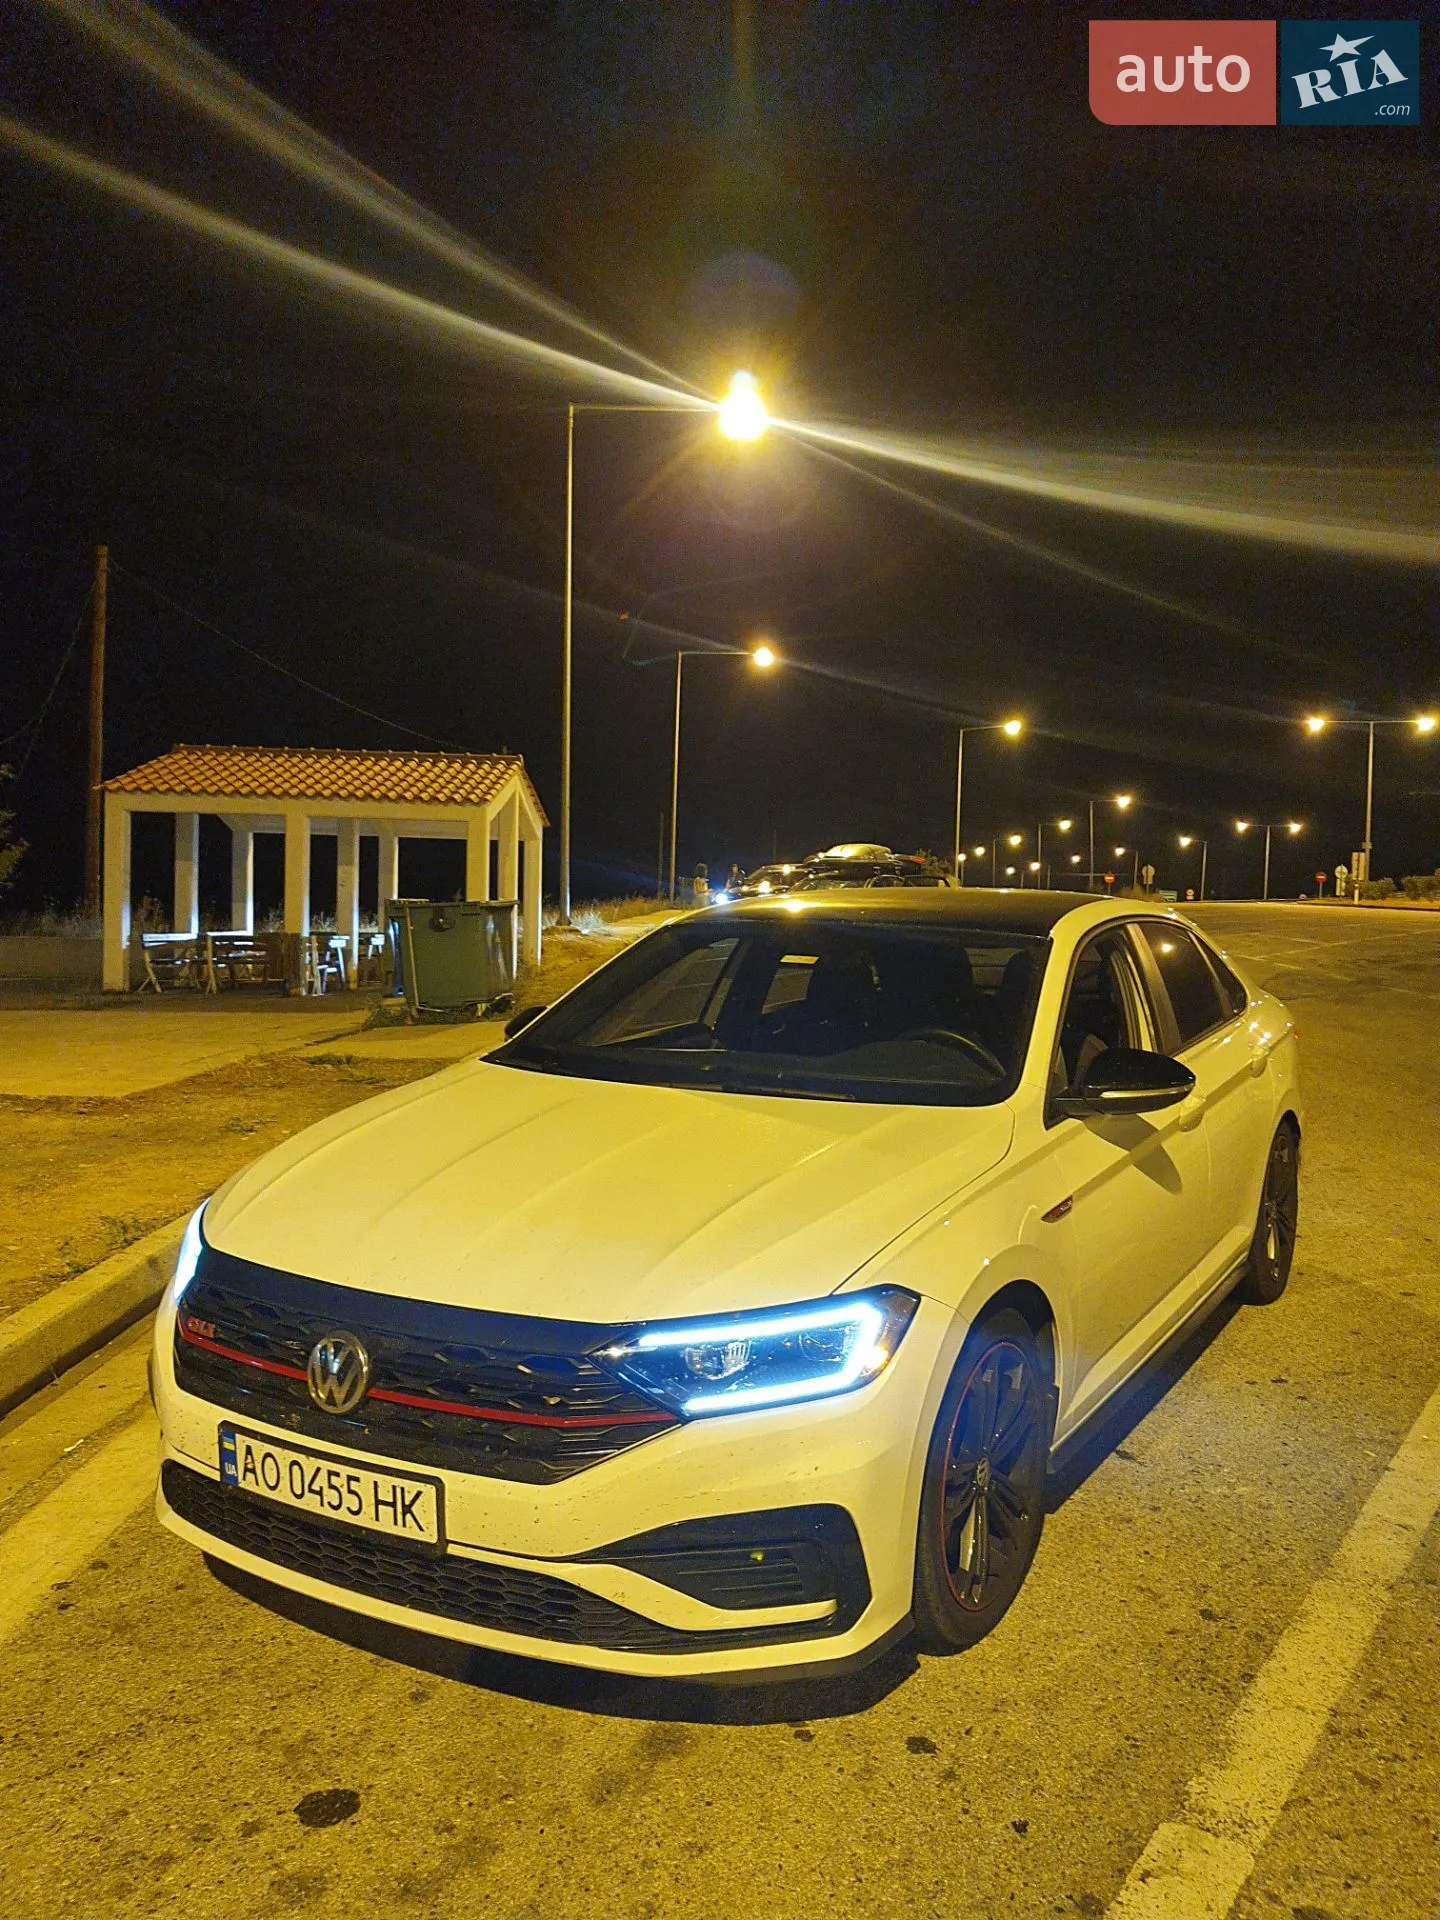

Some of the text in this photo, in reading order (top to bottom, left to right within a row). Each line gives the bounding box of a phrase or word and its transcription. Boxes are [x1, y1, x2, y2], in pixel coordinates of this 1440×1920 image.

[224, 1462, 238, 1477] UA
[243, 1444, 425, 1532] AO 0455 HK
